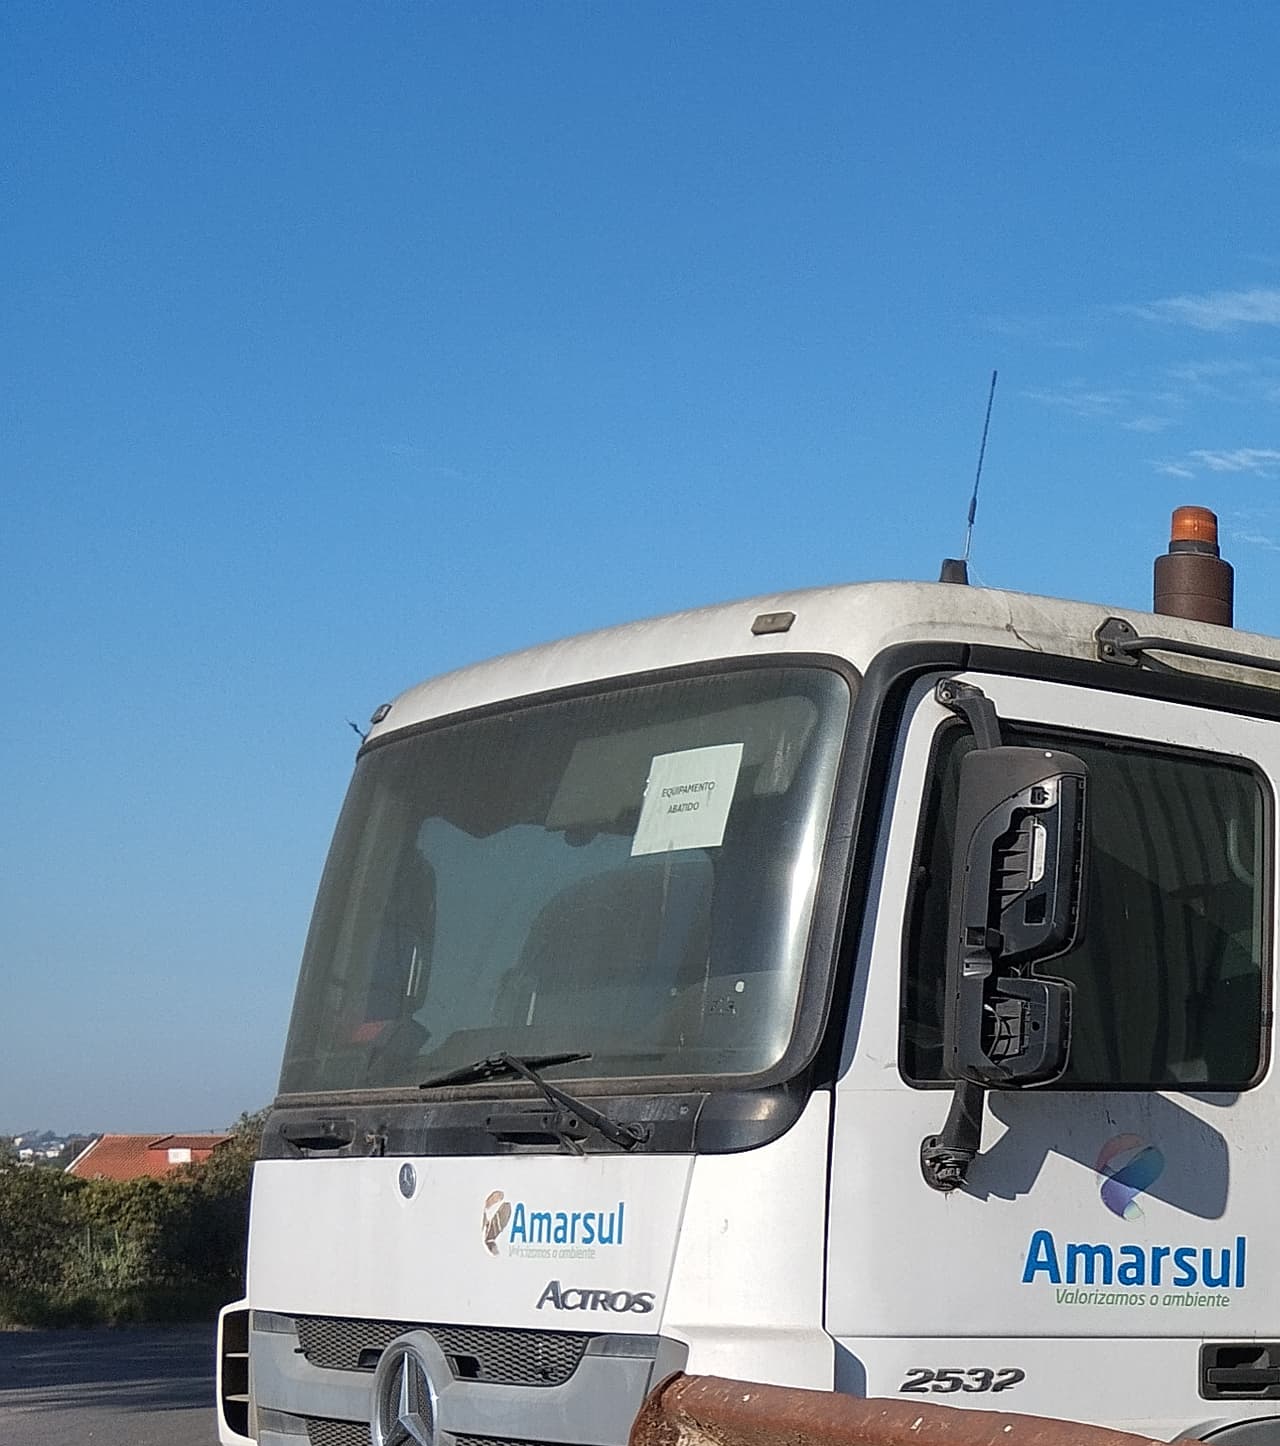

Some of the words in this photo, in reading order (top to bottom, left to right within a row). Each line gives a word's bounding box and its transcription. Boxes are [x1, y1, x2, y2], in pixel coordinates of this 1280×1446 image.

[661, 781, 716, 798] EQUIPAMENTO
[667, 802, 700, 814] ABATIDO
[510, 1202, 625, 1244] Amarsul
[1022, 1230, 1247, 1288] Amarsul
[1056, 1288, 1146, 1306] Valorizamos
[1149, 1294, 1158, 1306] o
[1162, 1291, 1231, 1307] ambiente
[899, 1367, 1026, 1393] 2532
